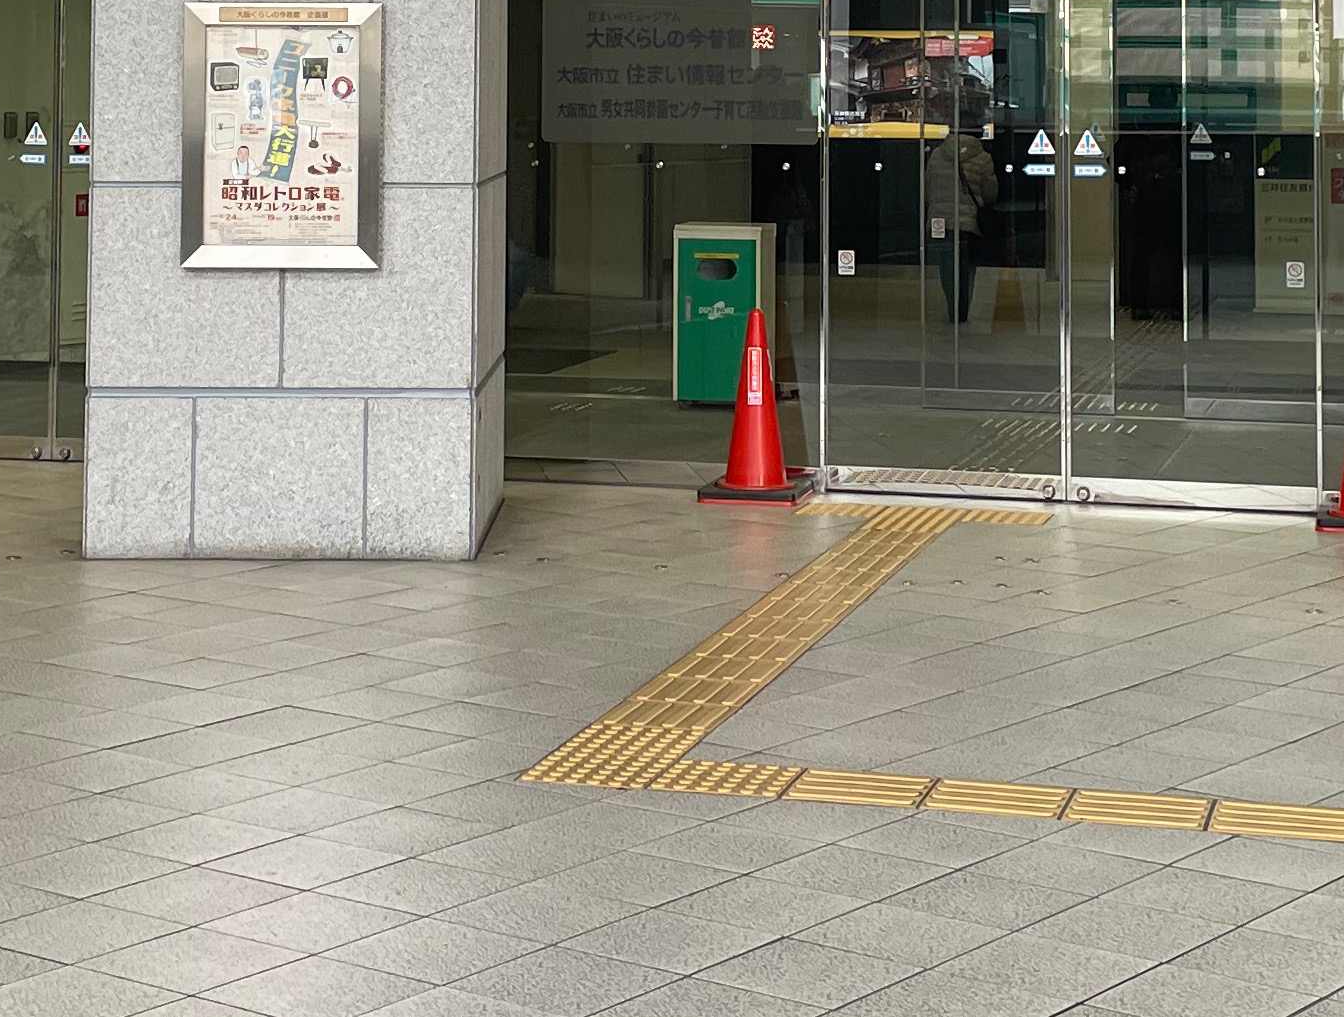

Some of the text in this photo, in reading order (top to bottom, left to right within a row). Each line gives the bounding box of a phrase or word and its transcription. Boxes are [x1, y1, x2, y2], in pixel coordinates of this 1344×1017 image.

[585, 27, 746, 50] 大阪くらしの今昔館
[556, 66, 620, 85] 大阪市立
[221, 186, 341, 201] 昭和レトロ家電
